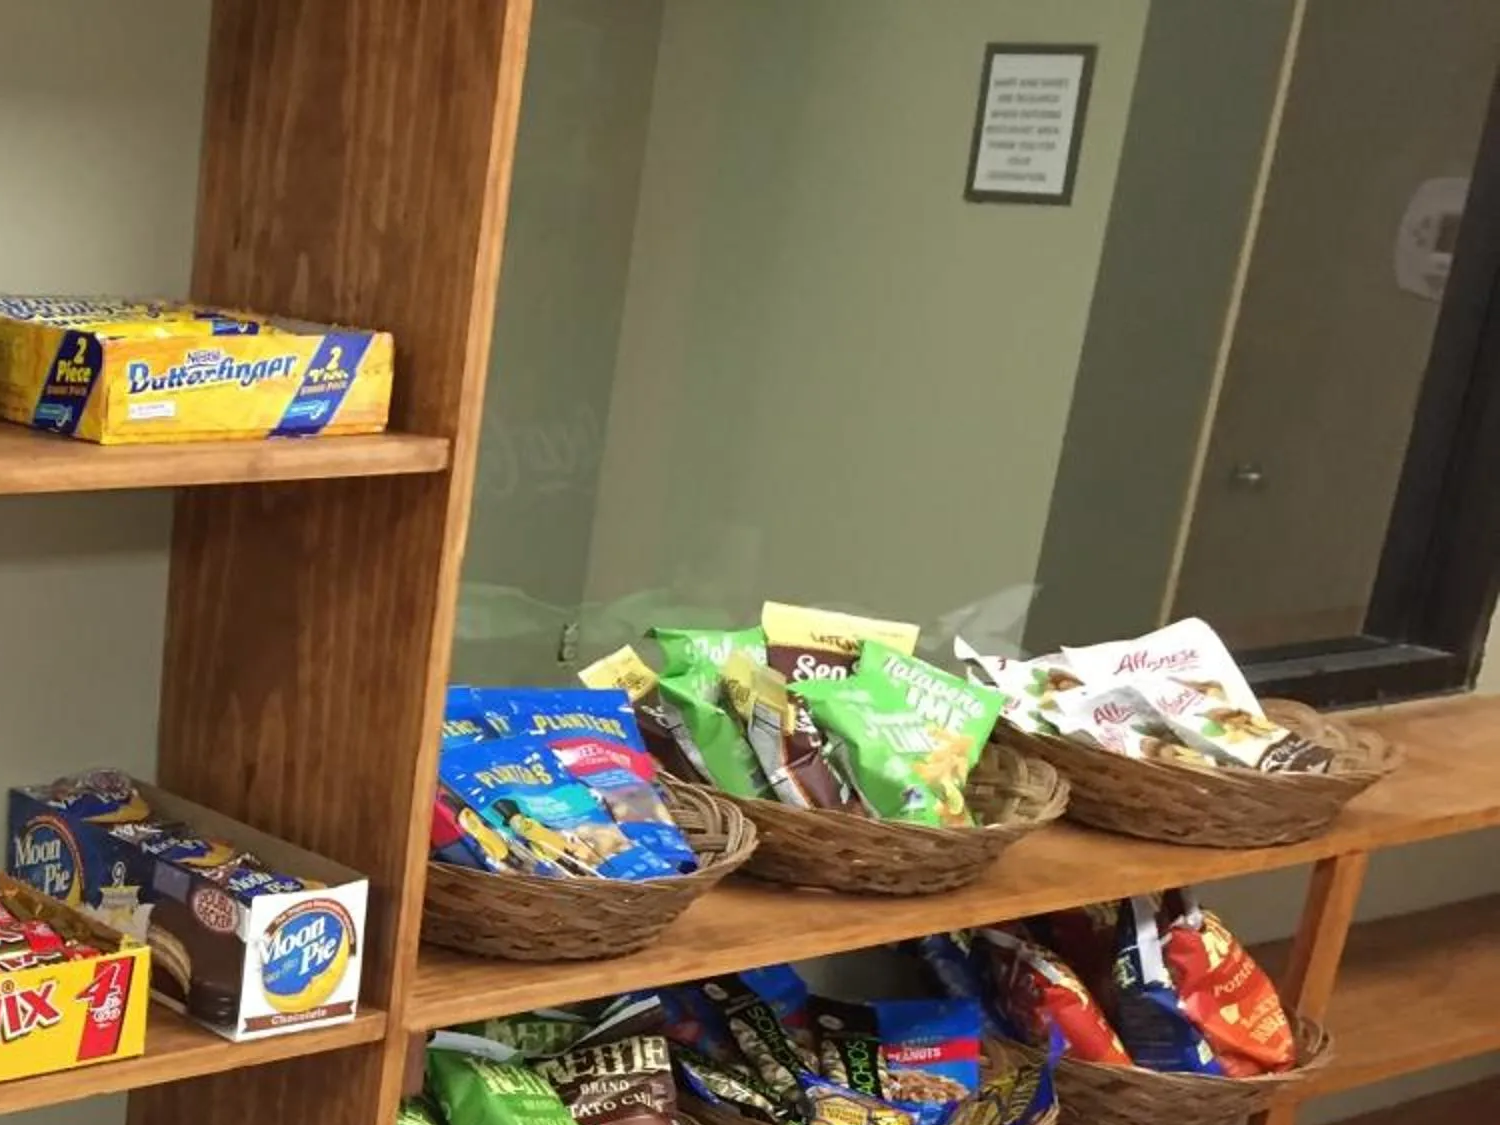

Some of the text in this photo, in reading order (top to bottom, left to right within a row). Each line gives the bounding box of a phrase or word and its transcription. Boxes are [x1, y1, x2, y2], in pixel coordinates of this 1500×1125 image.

[73, 337, 87, 364] 2
[128, 357, 296, 393] Butterfinger
[14, 834, 61, 868] Moon
[44, 861, 71, 894] Pie
[259, 915, 326, 962] Moon
[300, 937, 336, 976] Pie
[569, 1099, 616, 1119] TATO
